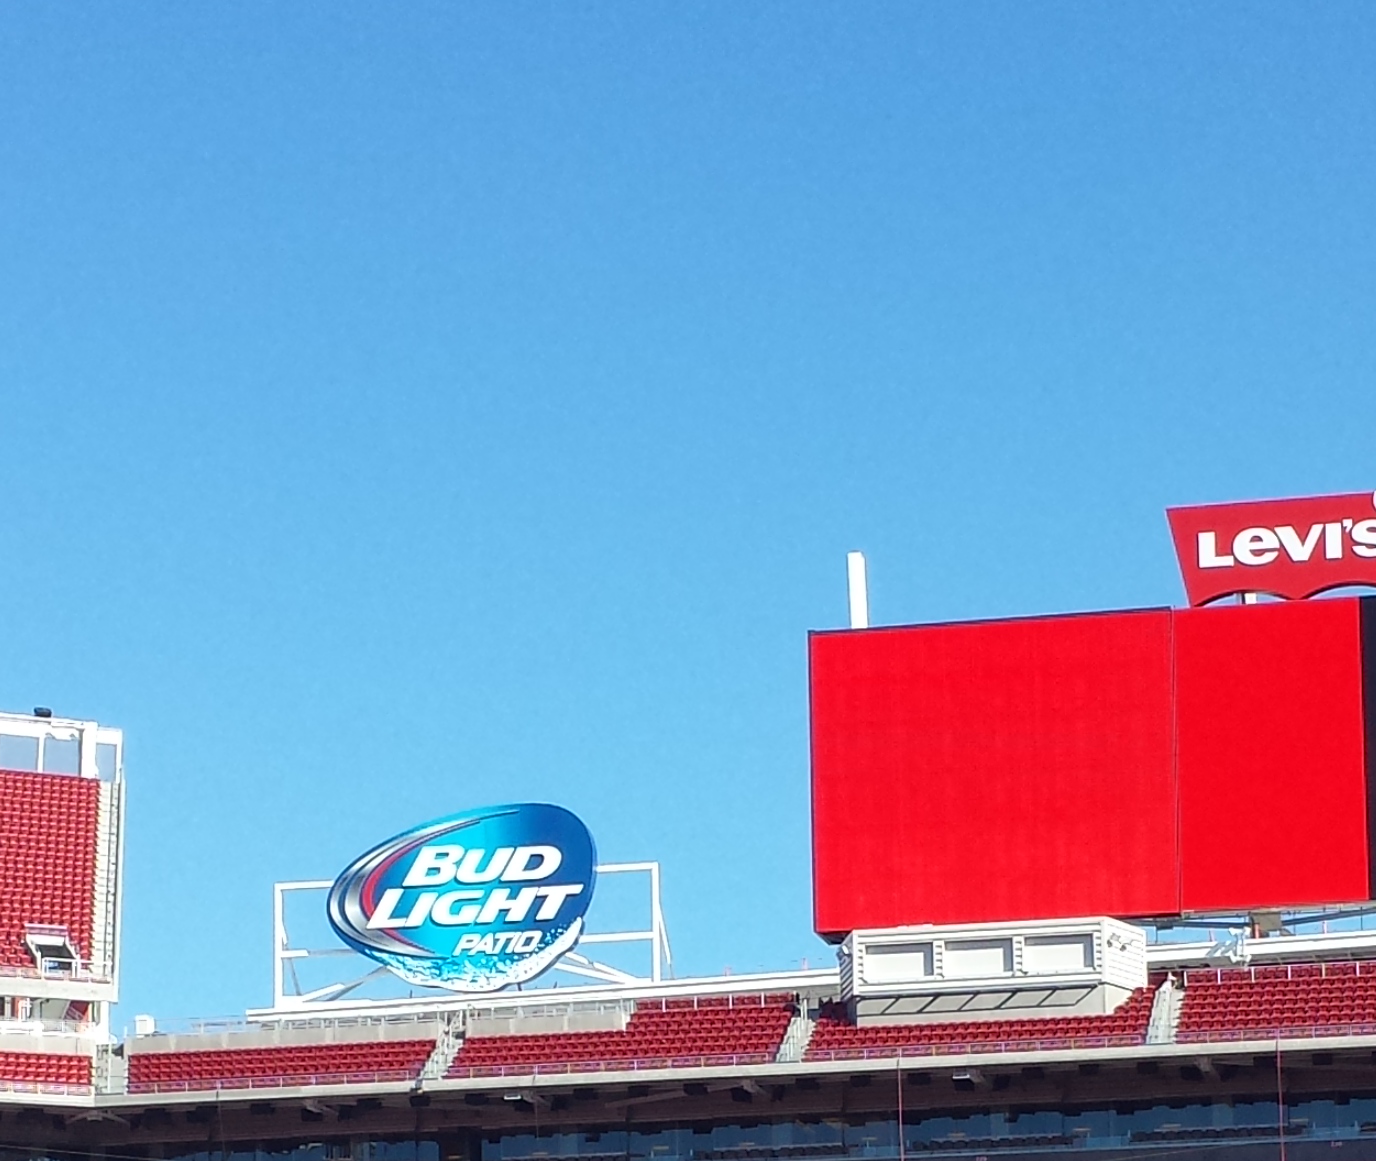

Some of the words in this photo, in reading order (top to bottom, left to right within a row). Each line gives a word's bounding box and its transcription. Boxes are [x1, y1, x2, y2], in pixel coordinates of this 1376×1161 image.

[402, 844, 562, 887] BUD
[366, 883, 584, 928] LIGHT
[452, 929, 543, 957] PATIO
